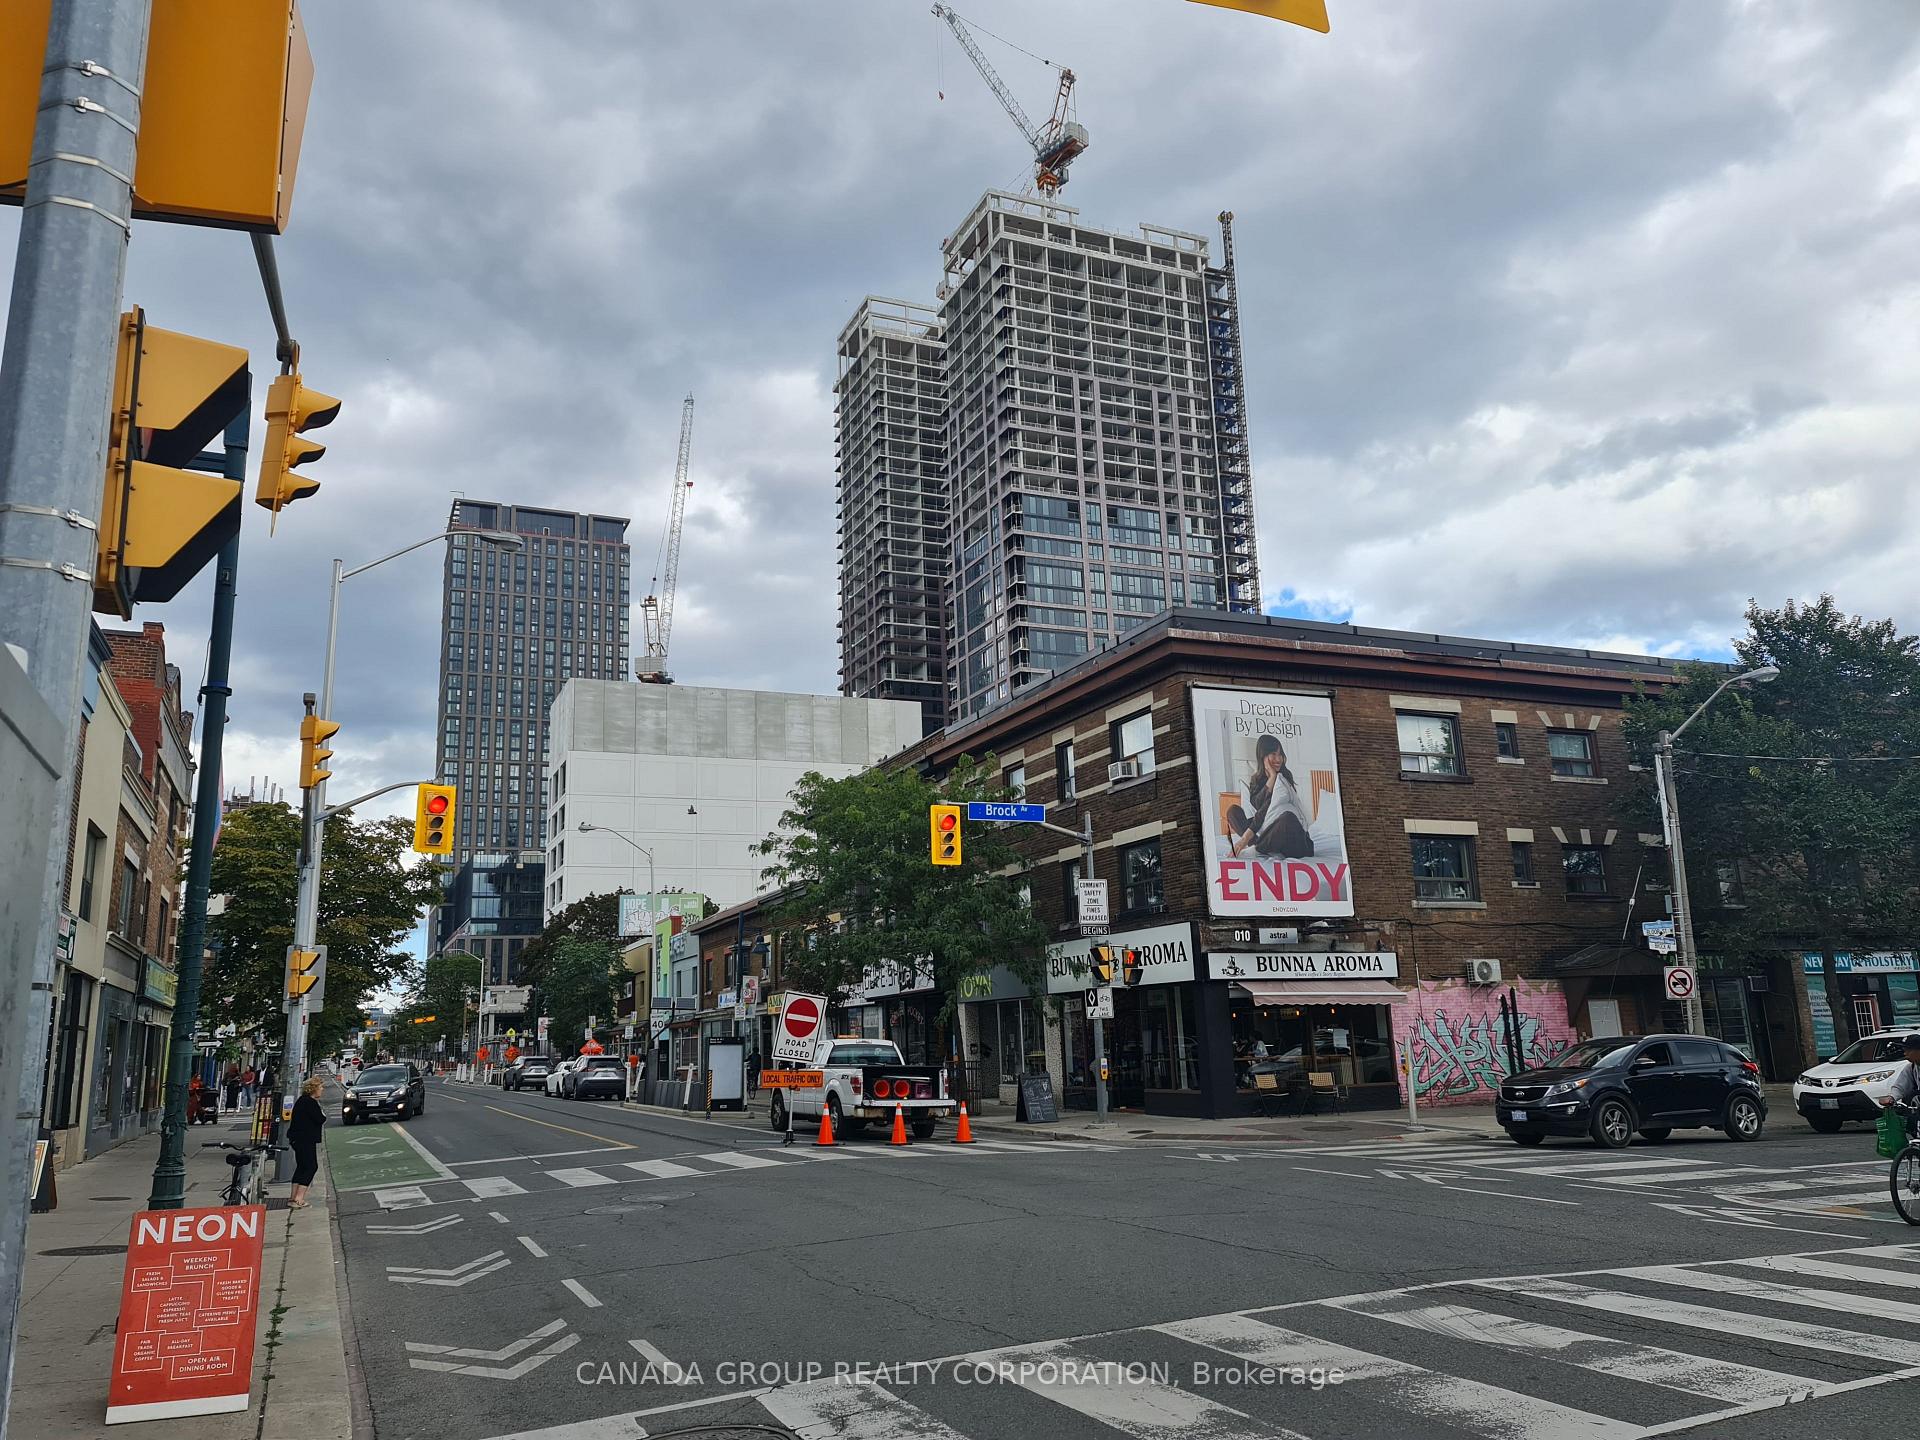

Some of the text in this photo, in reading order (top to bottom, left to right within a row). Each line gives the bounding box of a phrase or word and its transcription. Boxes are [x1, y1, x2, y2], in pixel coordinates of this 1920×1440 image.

[1239, 699, 1294, 722] Dreamy
[1235, 716, 1302, 738] By Design
[986, 804, 1017, 817] Brock
[1215, 861, 1348, 901] ENDY
[1082, 926, 1108, 935] BEGINS
[1234, 930, 1251, 942] 010
[1269, 930, 1289, 940] astral
[1052, 953, 1092, 977] BUNNA
[1256, 956, 1317, 972] BUNNA
[1323, 955, 1384, 972] AROMA
[1851, 955, 1912, 967] UHOLSTERY
[652, 1020, 664, 1029] 40
[785, 1039, 807, 1048] ROAD
[778, 1048, 810, 1058] CLOSED
[763, 1075, 821, 1083] LOCAL TRAFFIC ONLY
[137, 1211, 258, 1245] NEON
[183, 1256, 218, 1264] WEEKEND
[185, 1263, 214, 1271] BRUNCH
[179, 1364, 204, 1373] DINING
